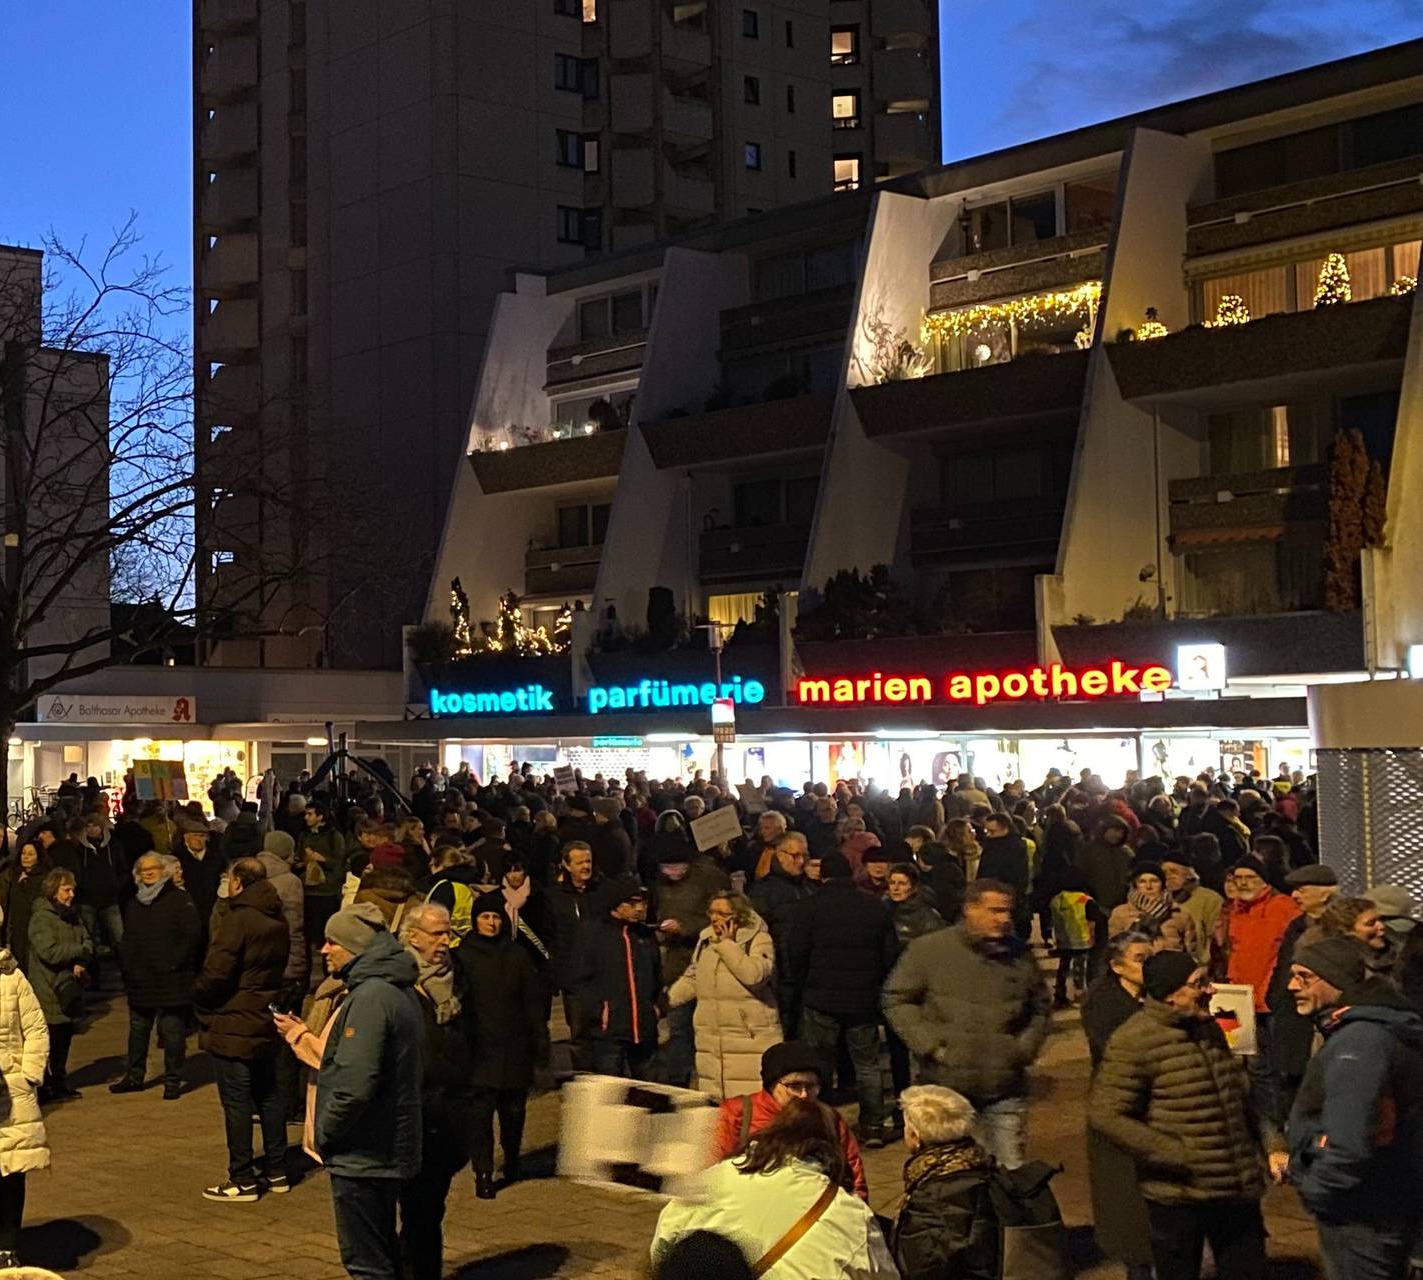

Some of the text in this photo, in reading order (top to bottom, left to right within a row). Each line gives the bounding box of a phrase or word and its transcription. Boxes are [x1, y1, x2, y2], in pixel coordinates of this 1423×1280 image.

[431, 677, 764, 714] kosmetik parfümerie
[798, 672, 931, 702] marien
[949, 660, 1173, 705] apotheke
[79, 704, 165, 719] Balthasar Apotheke
